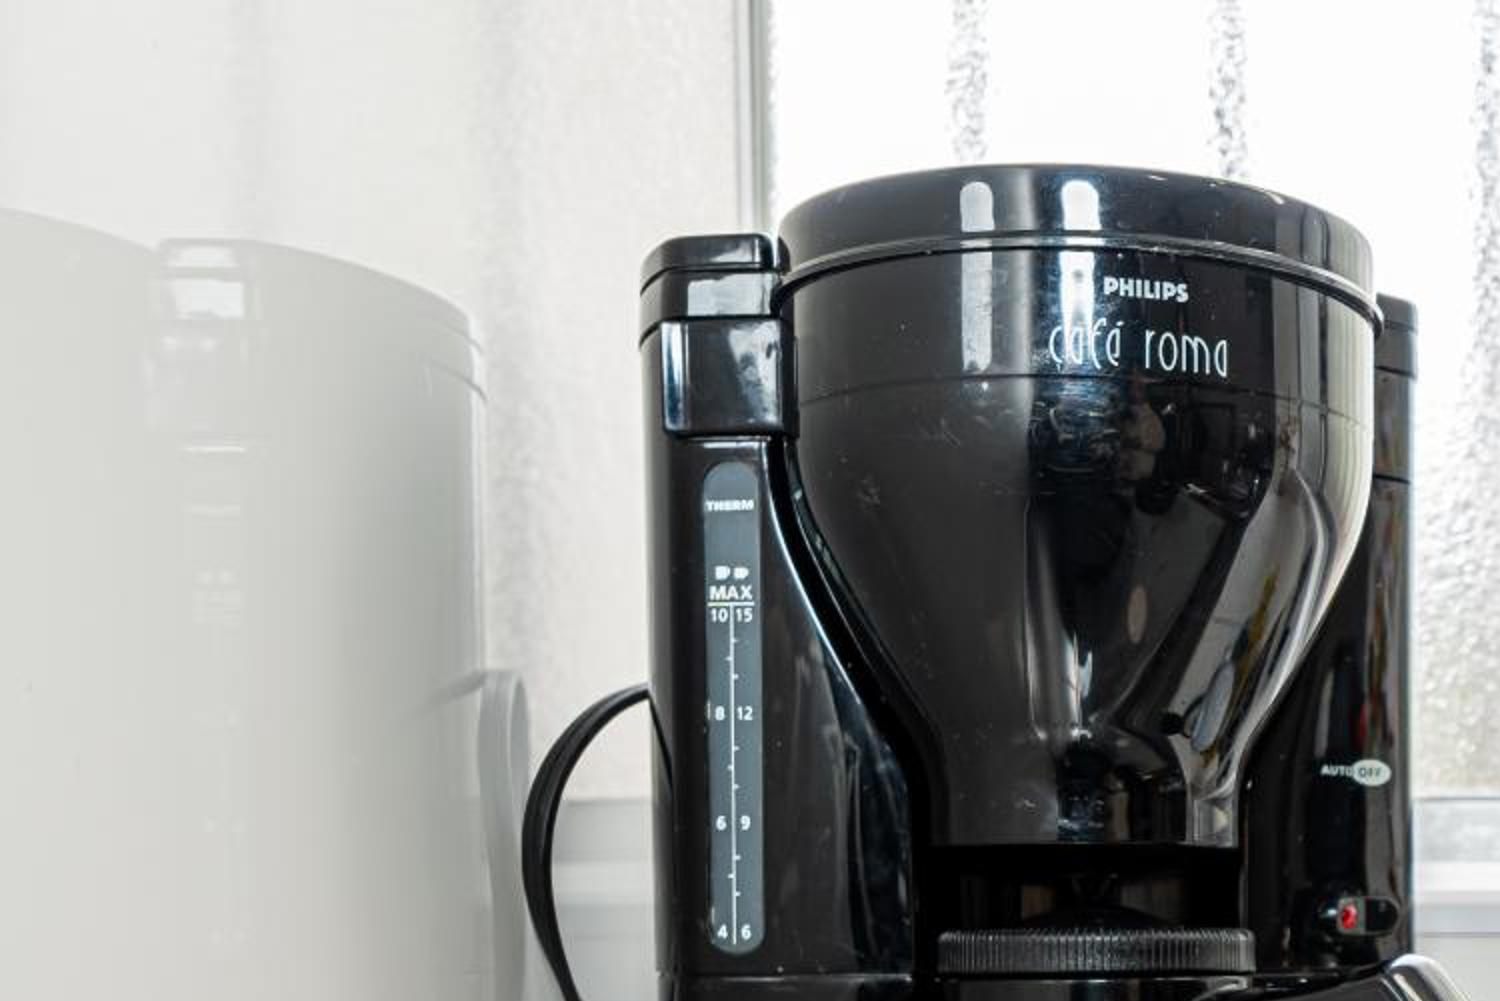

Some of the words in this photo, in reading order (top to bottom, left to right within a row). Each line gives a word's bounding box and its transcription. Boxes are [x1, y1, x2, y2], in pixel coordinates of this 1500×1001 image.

[1103, 276, 1189, 302] PHILIPS
[1145, 329, 1228, 378] roma
[705, 499, 755, 511] THERM
[709, 585, 753, 600] MAX
[711, 607, 729, 623] 10
[735, 607, 753, 623] 15
[715, 706, 725, 721] 8
[736, 706, 753, 721] 12
[1320, 764, 1354, 777] AUTO
[716, 816, 727, 832] 6
[740, 816, 751, 832] 9
[717, 925, 728, 940] 4
[741, 925, 752, 940] 6
